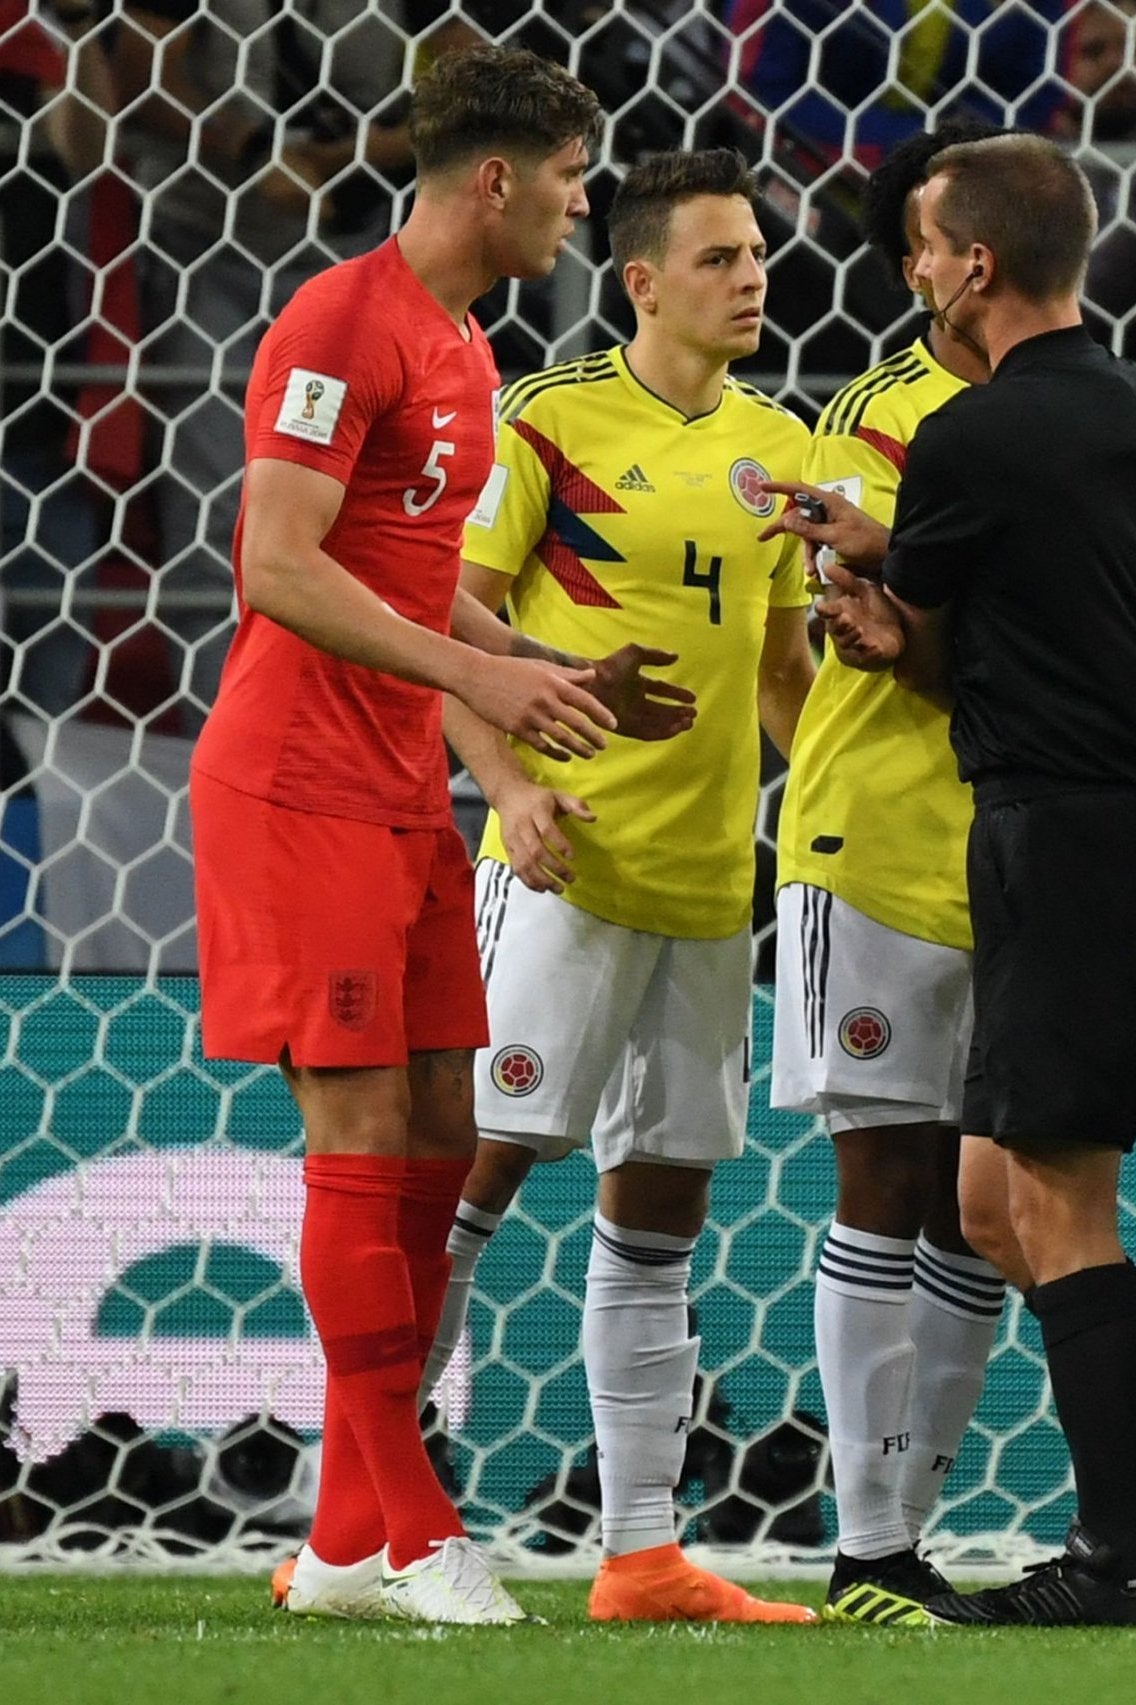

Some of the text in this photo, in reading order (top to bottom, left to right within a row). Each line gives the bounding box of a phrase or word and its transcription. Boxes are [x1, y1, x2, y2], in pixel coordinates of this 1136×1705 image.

[402, 441, 456, 517] 5
[615, 481, 656, 493] adidas
[682, 540, 723, 625] 4
